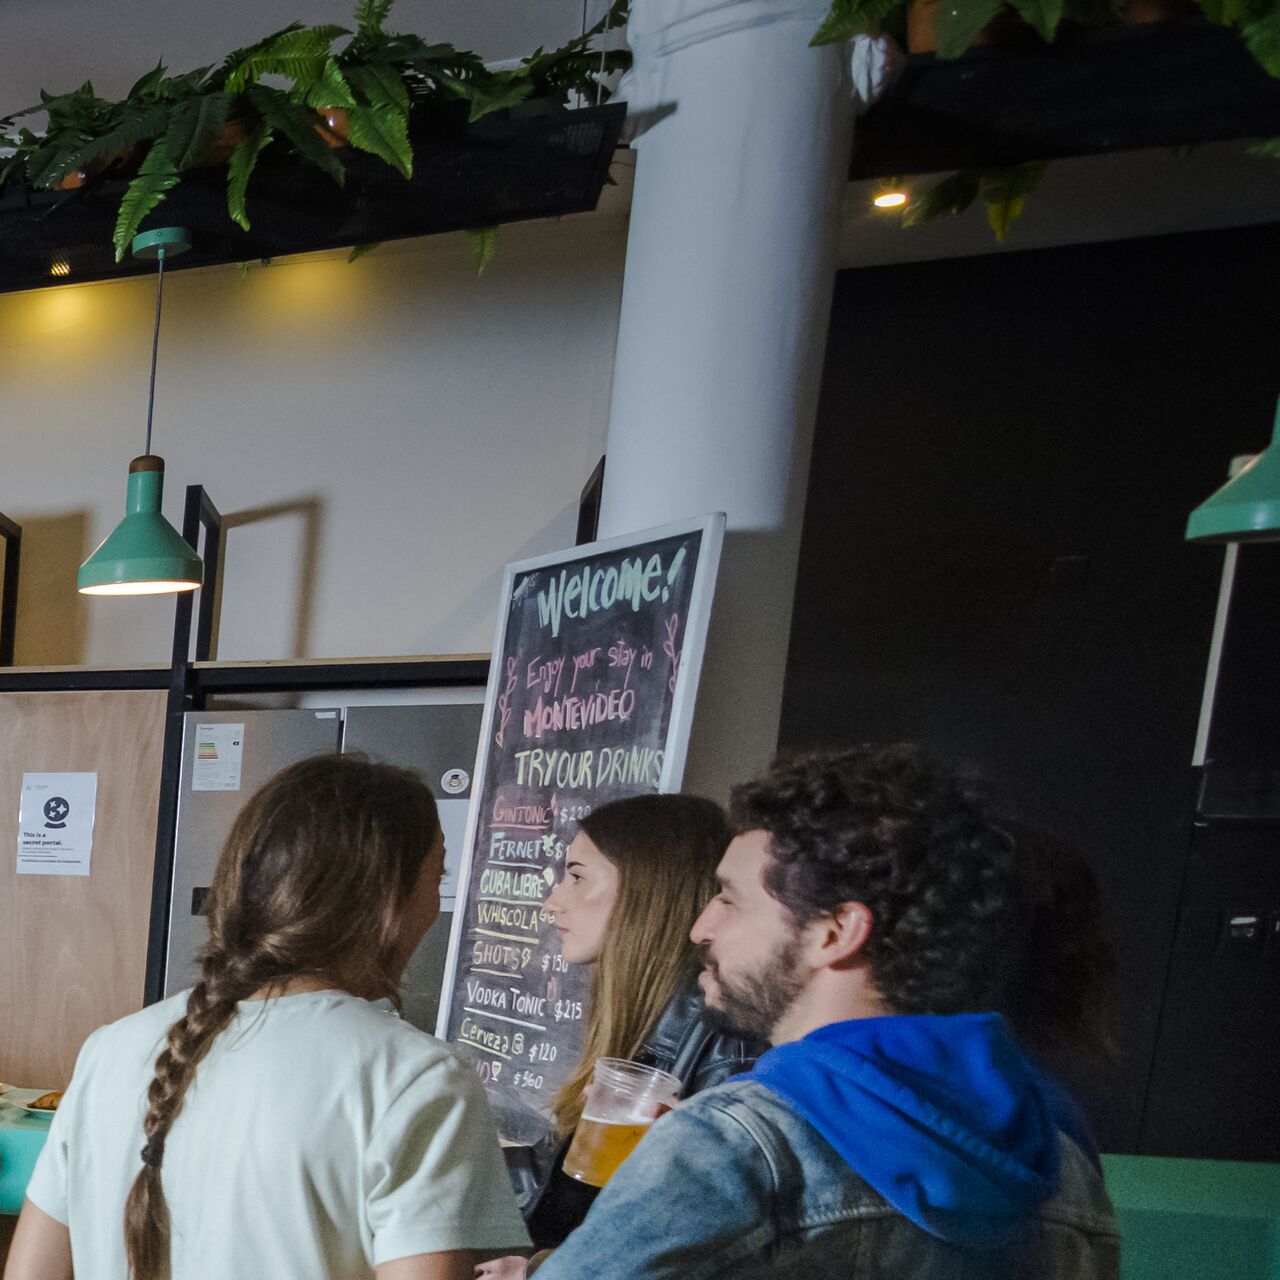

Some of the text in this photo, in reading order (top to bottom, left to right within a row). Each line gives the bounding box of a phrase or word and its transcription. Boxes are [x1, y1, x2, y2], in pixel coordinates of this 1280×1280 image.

[536, 547, 687, 638] Welcome!
[526, 636, 653, 697] Enjoy your stay in
[595, 745, 665, 788] DRINKS
[490, 831, 542, 860] FERNET
[472, 940, 522, 970] SHOTS
[467, 980, 582, 1022] VODKA TONIC $215
[460, 1017, 557, 1062] Cerveza $120
